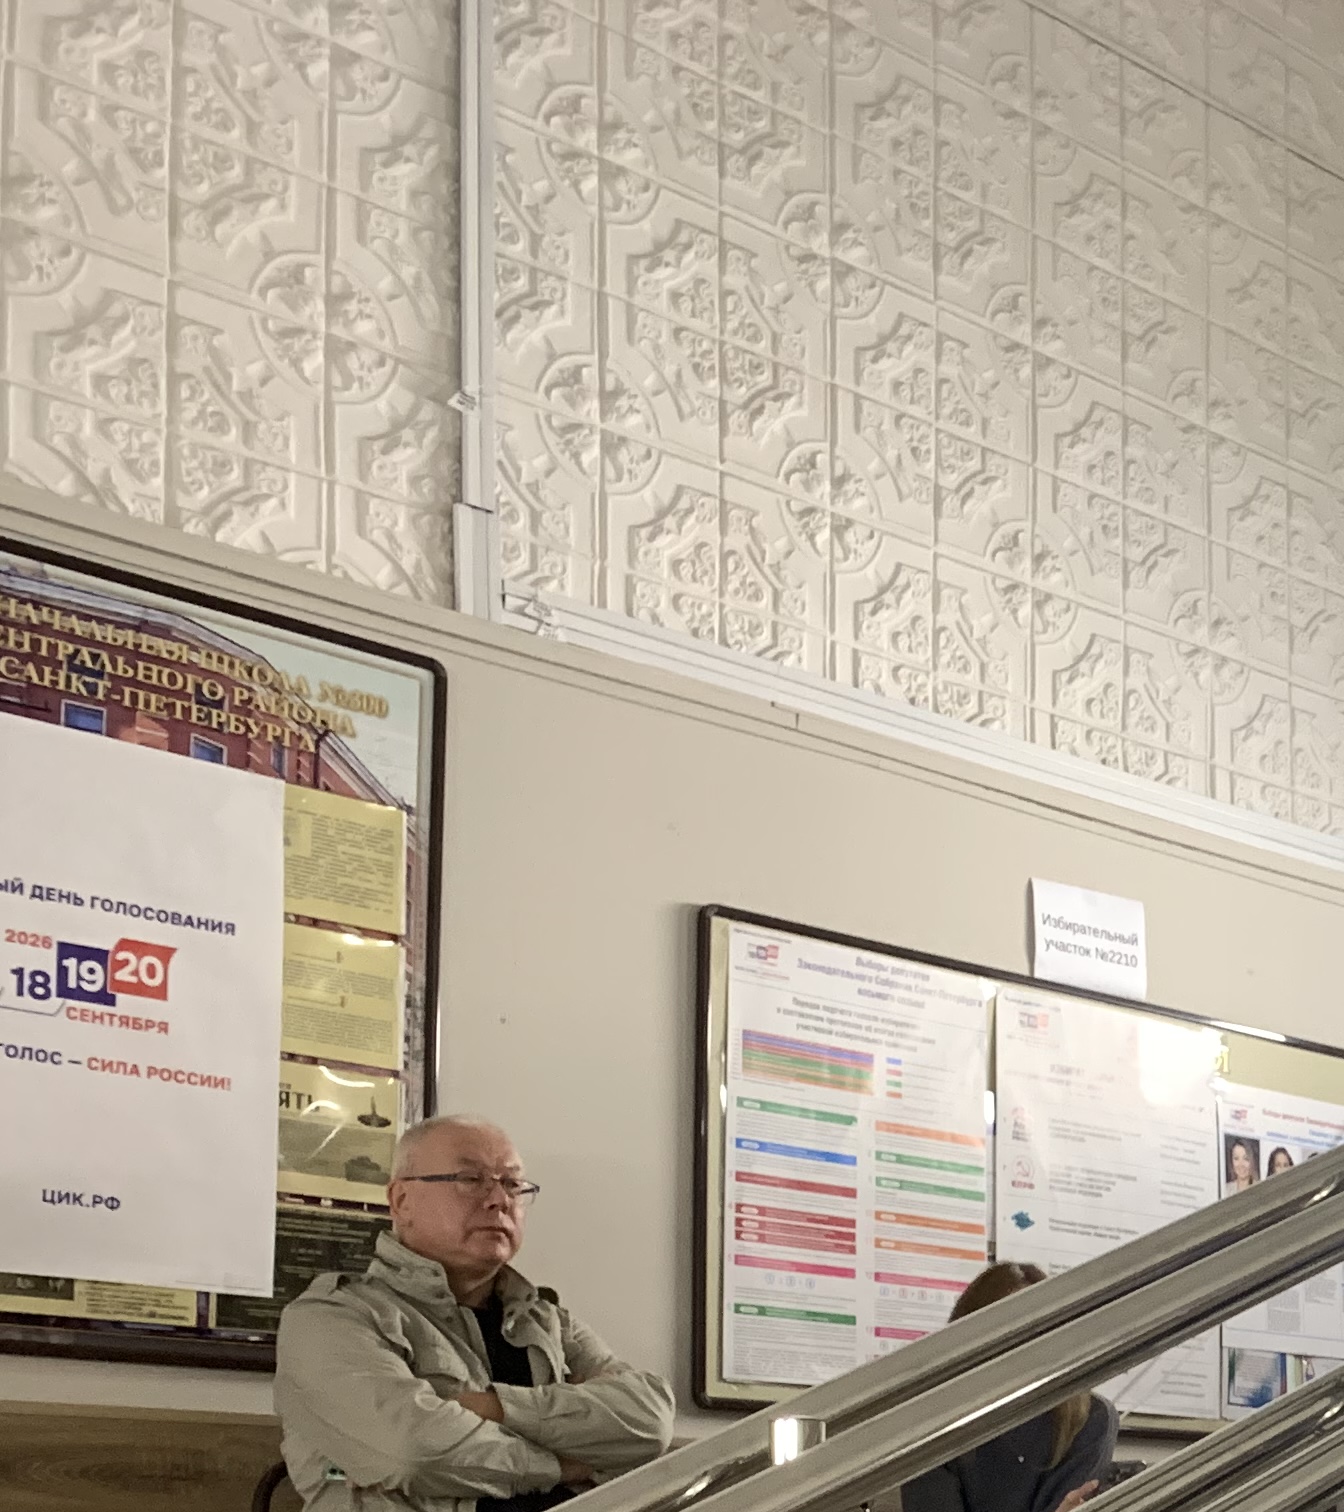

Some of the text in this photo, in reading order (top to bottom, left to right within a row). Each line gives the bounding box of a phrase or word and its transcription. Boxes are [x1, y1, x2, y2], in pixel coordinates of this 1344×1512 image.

[0, 625, 357, 739] НТРАЛЬНОГО РАЙОНА
[200, 648, 311, 699] ШКОЛА
[1, 656, 318, 753] САНКТ-ПЕТЕРБУРГА
[29, 885, 84, 907] ДЕНЬ
[90, 896, 236, 936] ГОЛОСОВАНИЯ
[4, 929, 53, 950] 2026
[1041, 912, 1139, 947] Избирательный
[114, 951, 165, 988] 20
[1044, 937, 1138, 968] участок №2210
[10, 966, 51, 1001] 18
[62, 957, 106, 993] 19
[66, 1006, 169, 1036] СЕНТЯБРЯ
[87, 1056, 141, 1078] СИЛА
[146, 1065, 231, 1091] РОССИИ!
[42, 1188, 121, 1212] ЦИК.РФ
